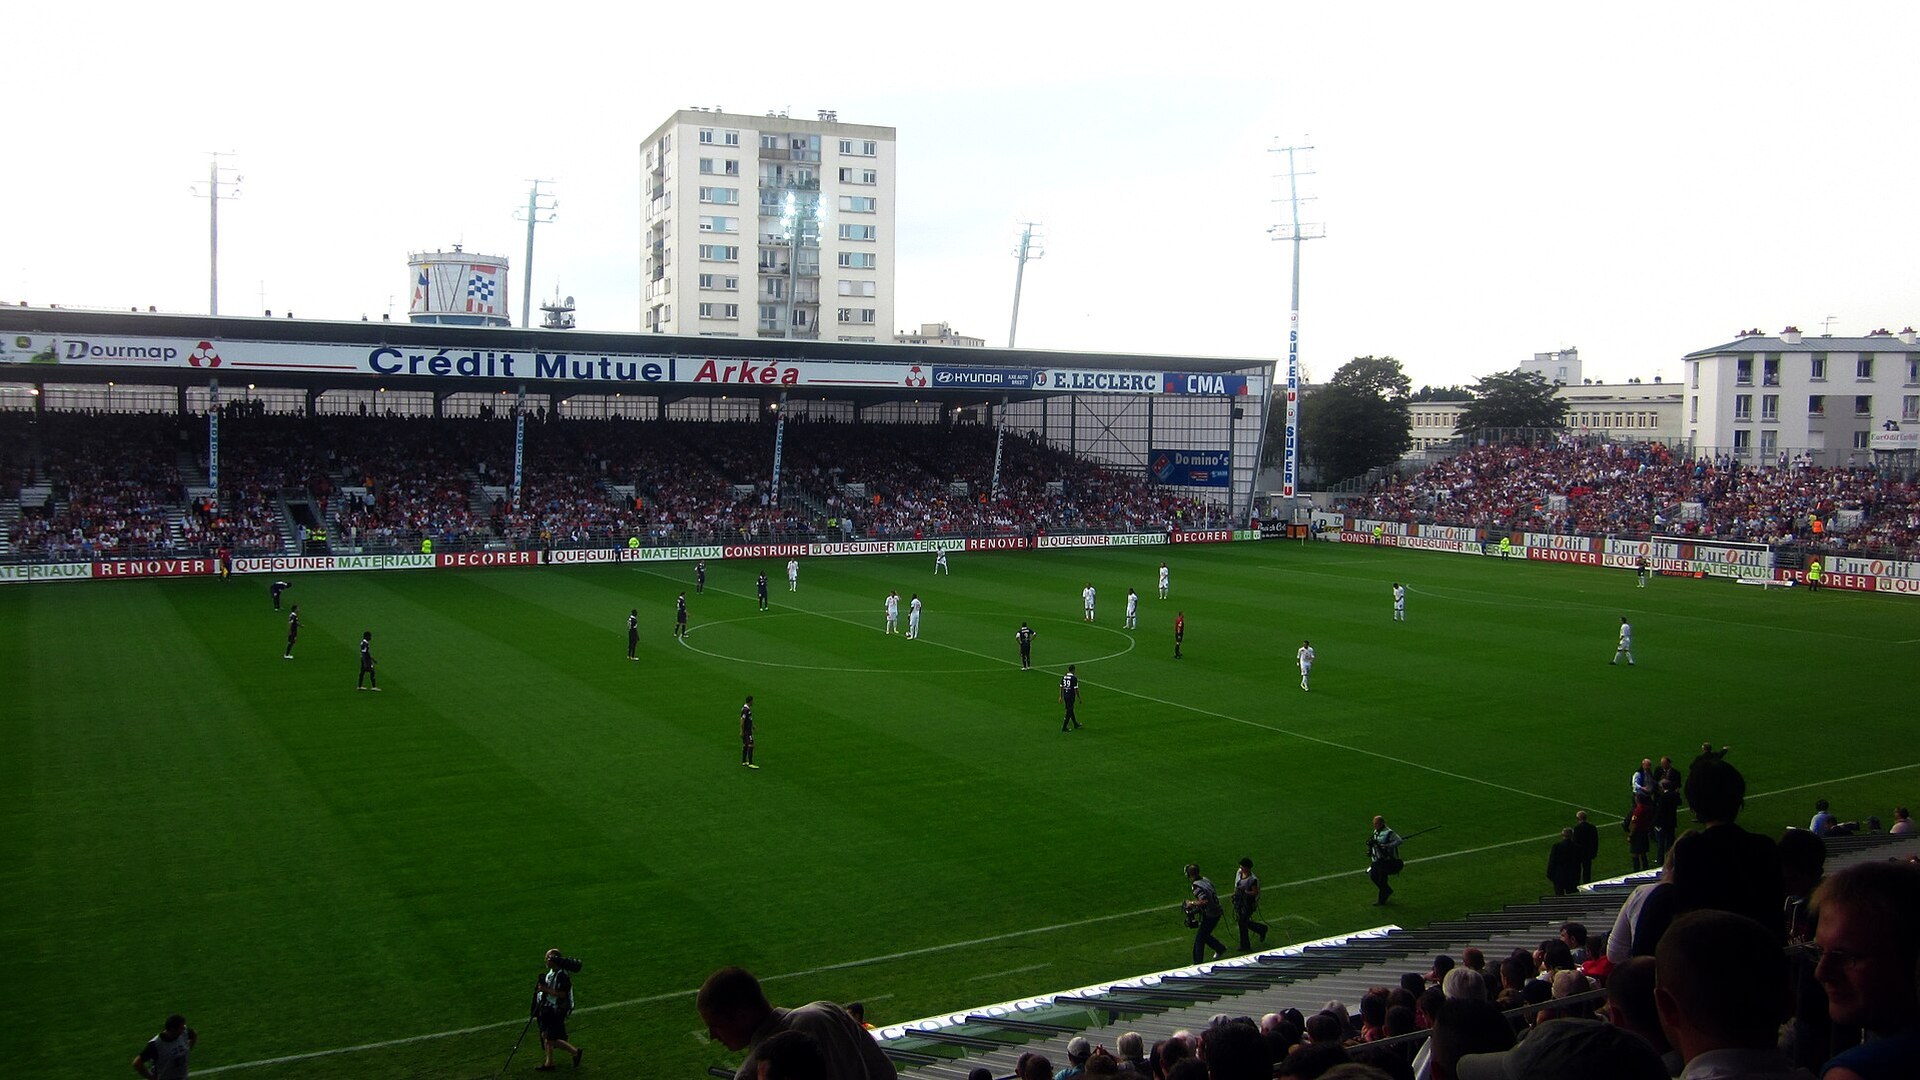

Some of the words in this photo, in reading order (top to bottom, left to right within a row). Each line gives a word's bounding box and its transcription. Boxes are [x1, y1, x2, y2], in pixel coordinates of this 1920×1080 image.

[63, 340, 178, 362] Dourmap
[368, 348, 514, 376] Crédit
[535, 354, 676, 382] Mutuel
[694, 359, 800, 384] Arkéa
[1288, 330, 1297, 388] SUPER
[954, 373, 1003, 383] HYUNDAI
[1054, 372, 1156, 390] E.LECLERC
[1187, 374, 1225, 394] CMA
[1176, 452, 1229, 466] Domino's
[1285, 426, 1294, 483] SUPER
[1284, 486, 1292, 496] U
[1050, 536, 1110, 546] QUEGUINER
[1175, 532, 1228, 542] DECORER
[1341, 532, 1396, 546] CONSTRIRE
[724, 545, 807, 557] CONSTRUIRE
[823, 542, 895, 555] QUEGUINER
[1408, 538, 1464, 551] QUEGUINER
[444, 552, 529, 566] DECORER
[642, 547, 720, 559] MATERIAUX
[1532, 548, 1596, 564] RENOVER
[101, 560, 204, 575] RENOVER
[236, 558, 334, 572] QUEGUINER
[338, 555, 432, 568] MATERIAUX
[0, 564, 88, 578] TERIAUX
